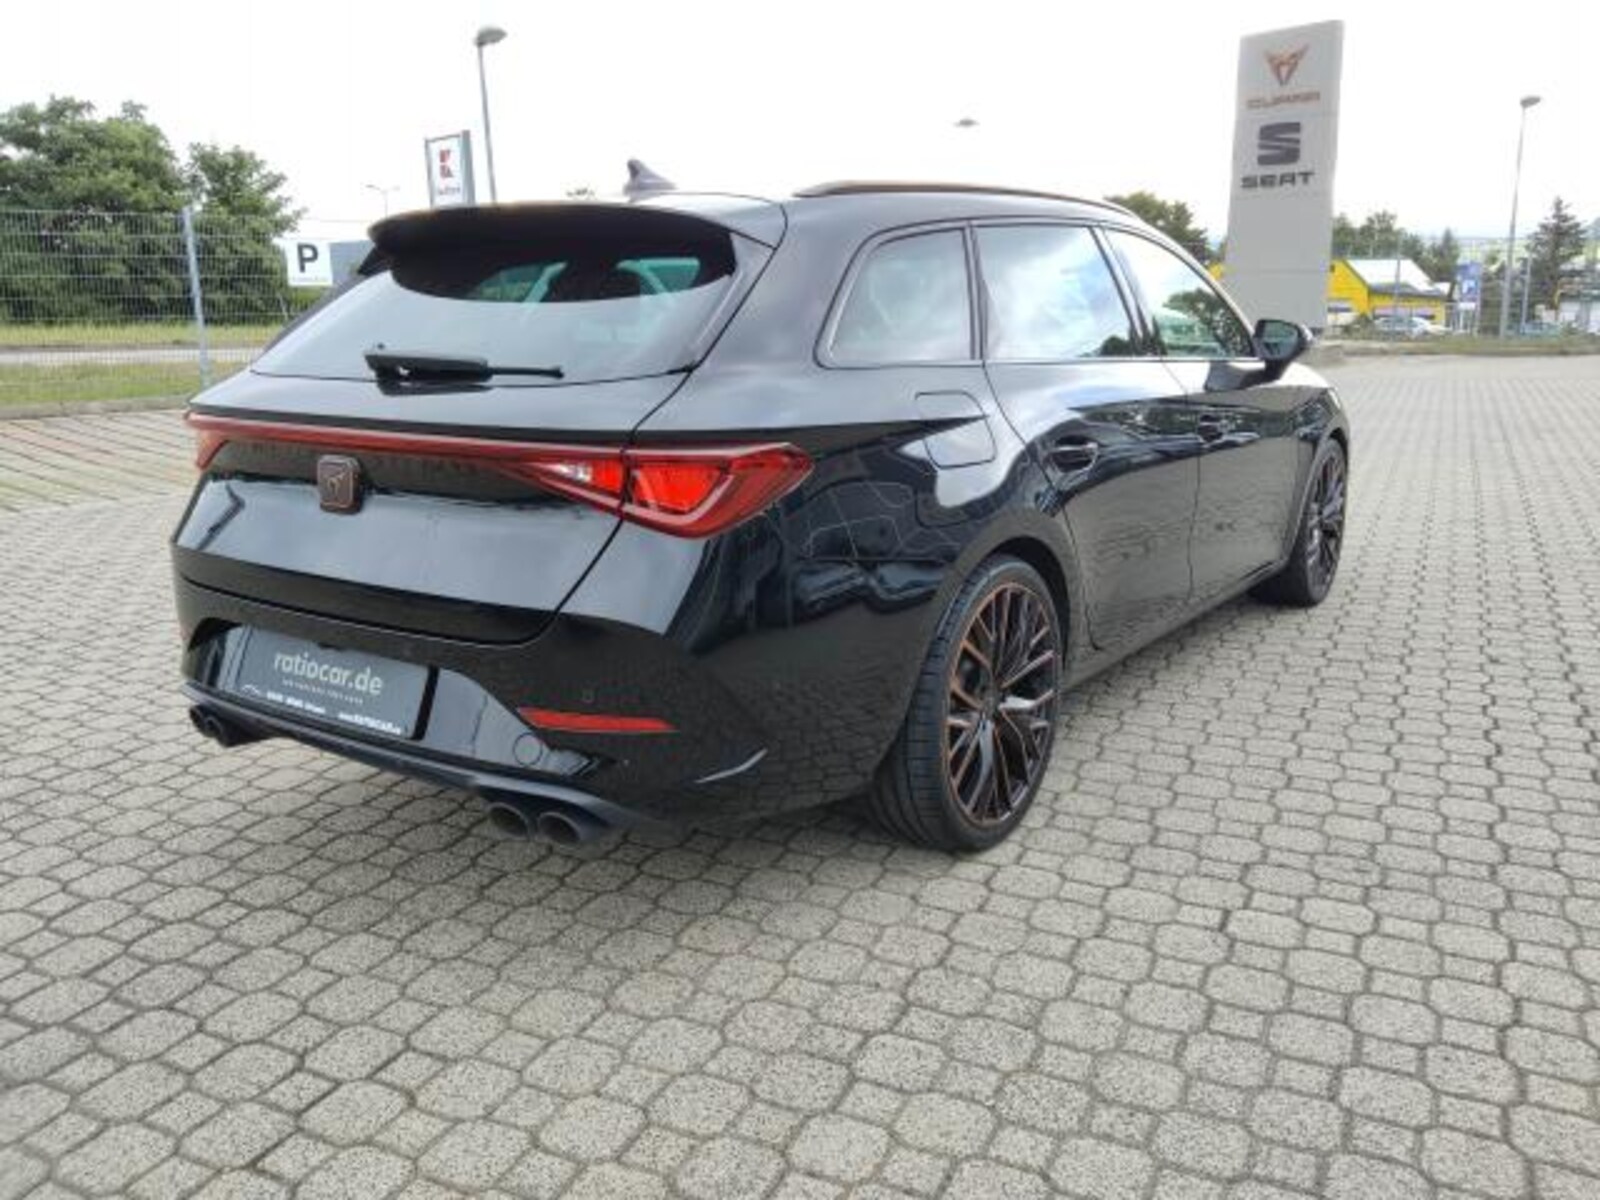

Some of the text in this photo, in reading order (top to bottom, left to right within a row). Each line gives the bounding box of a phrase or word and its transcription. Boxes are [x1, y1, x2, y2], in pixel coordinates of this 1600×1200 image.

[1241, 171, 1315, 189] SEAT
[297, 243, 318, 273] P
[274, 651, 383, 695] ratiocar.de
